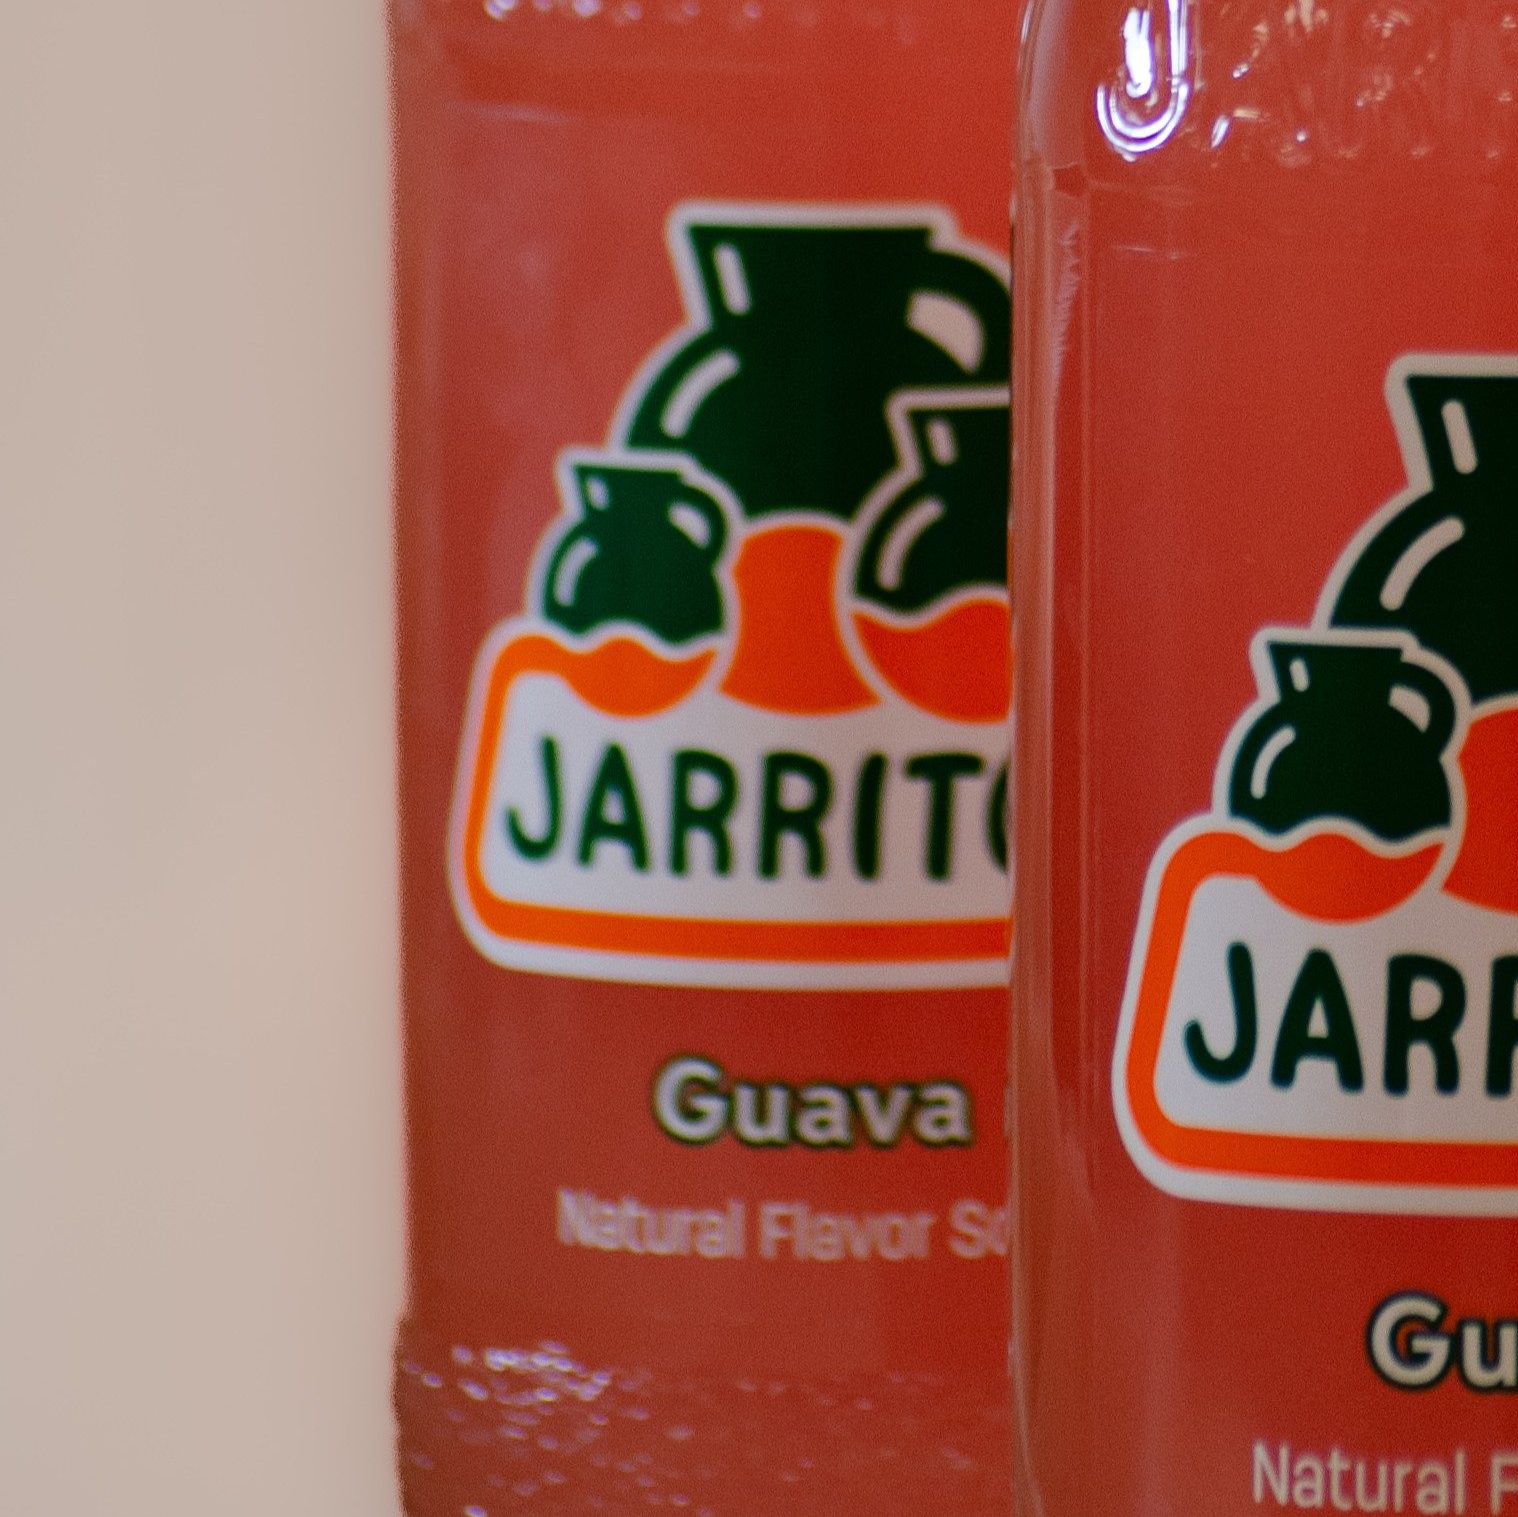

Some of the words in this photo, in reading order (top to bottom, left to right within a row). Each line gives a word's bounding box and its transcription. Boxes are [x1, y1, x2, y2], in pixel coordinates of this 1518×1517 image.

[506, 734, 1010, 882] JARRIT
[651, 1053, 975, 1148] Guava
[556, 1187, 746, 1259] Natural
[758, 1200, 938, 1262] Flavor
[1251, 1438, 1467, 1515] Natural
